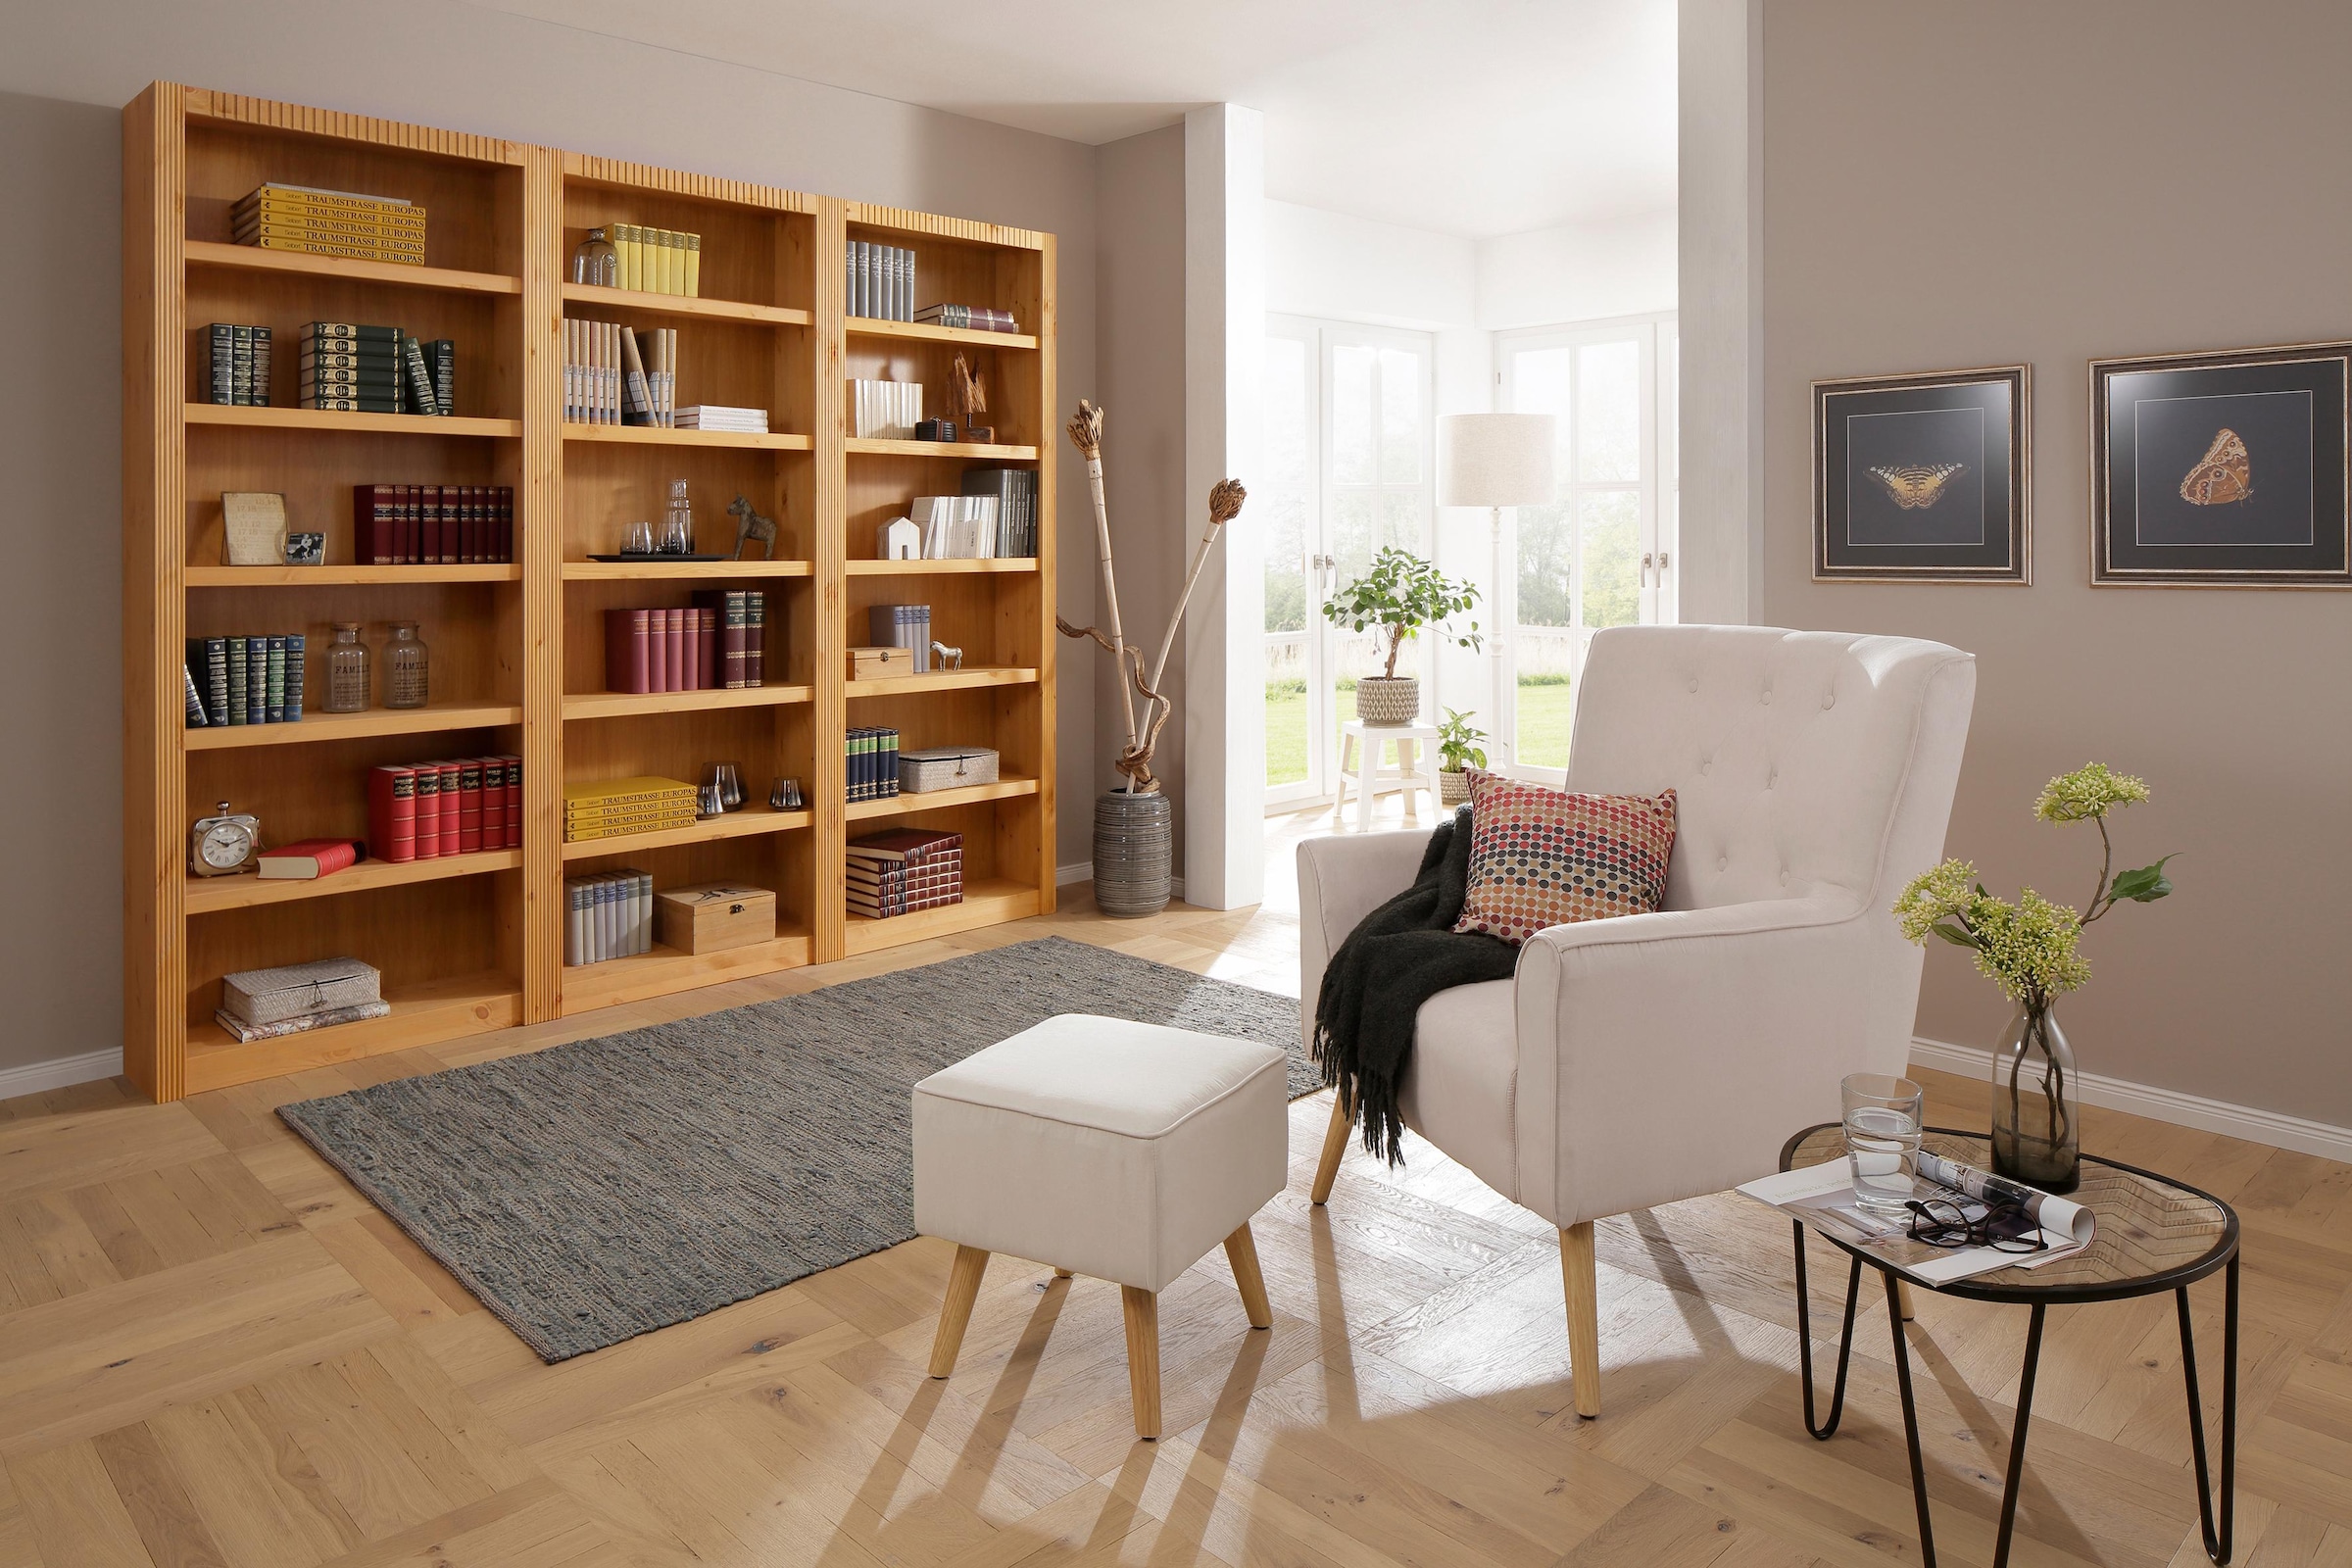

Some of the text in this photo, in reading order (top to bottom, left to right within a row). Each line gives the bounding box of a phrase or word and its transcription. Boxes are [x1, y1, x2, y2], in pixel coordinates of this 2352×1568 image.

[305, 195, 378, 210] TRAUMSTRASSE
[381, 204, 424, 216] EUROPAS
[305, 207, 378, 222] TRAUMSTRASSE
[381, 217, 424, 227] EUROPAS
[305, 219, 377, 234] TRAUMSTRASSE
[381, 228, 424, 240] EUROPAS
[304, 231, 377, 246] TRAUMSTRASSE
[381, 240, 423, 252] EUROPAS
[304, 243, 377, 258] TRAUMSTRASSE
[380, 252, 423, 264] EUROPAS
[602, 792, 660, 805] TRAUMSTRASSE
[662, 787, 696, 797] EUROPAS
[602, 802, 660, 815] TRAUMSTRASSE
[662, 798, 696, 808] EUROPAS
[602, 812, 660, 825] TRAUMSTRASSE
[662, 808, 696, 817] EUROPAS
[602, 822, 659, 836] TRAUMSTRASSE
[662, 817, 695, 828] EUROPAS
